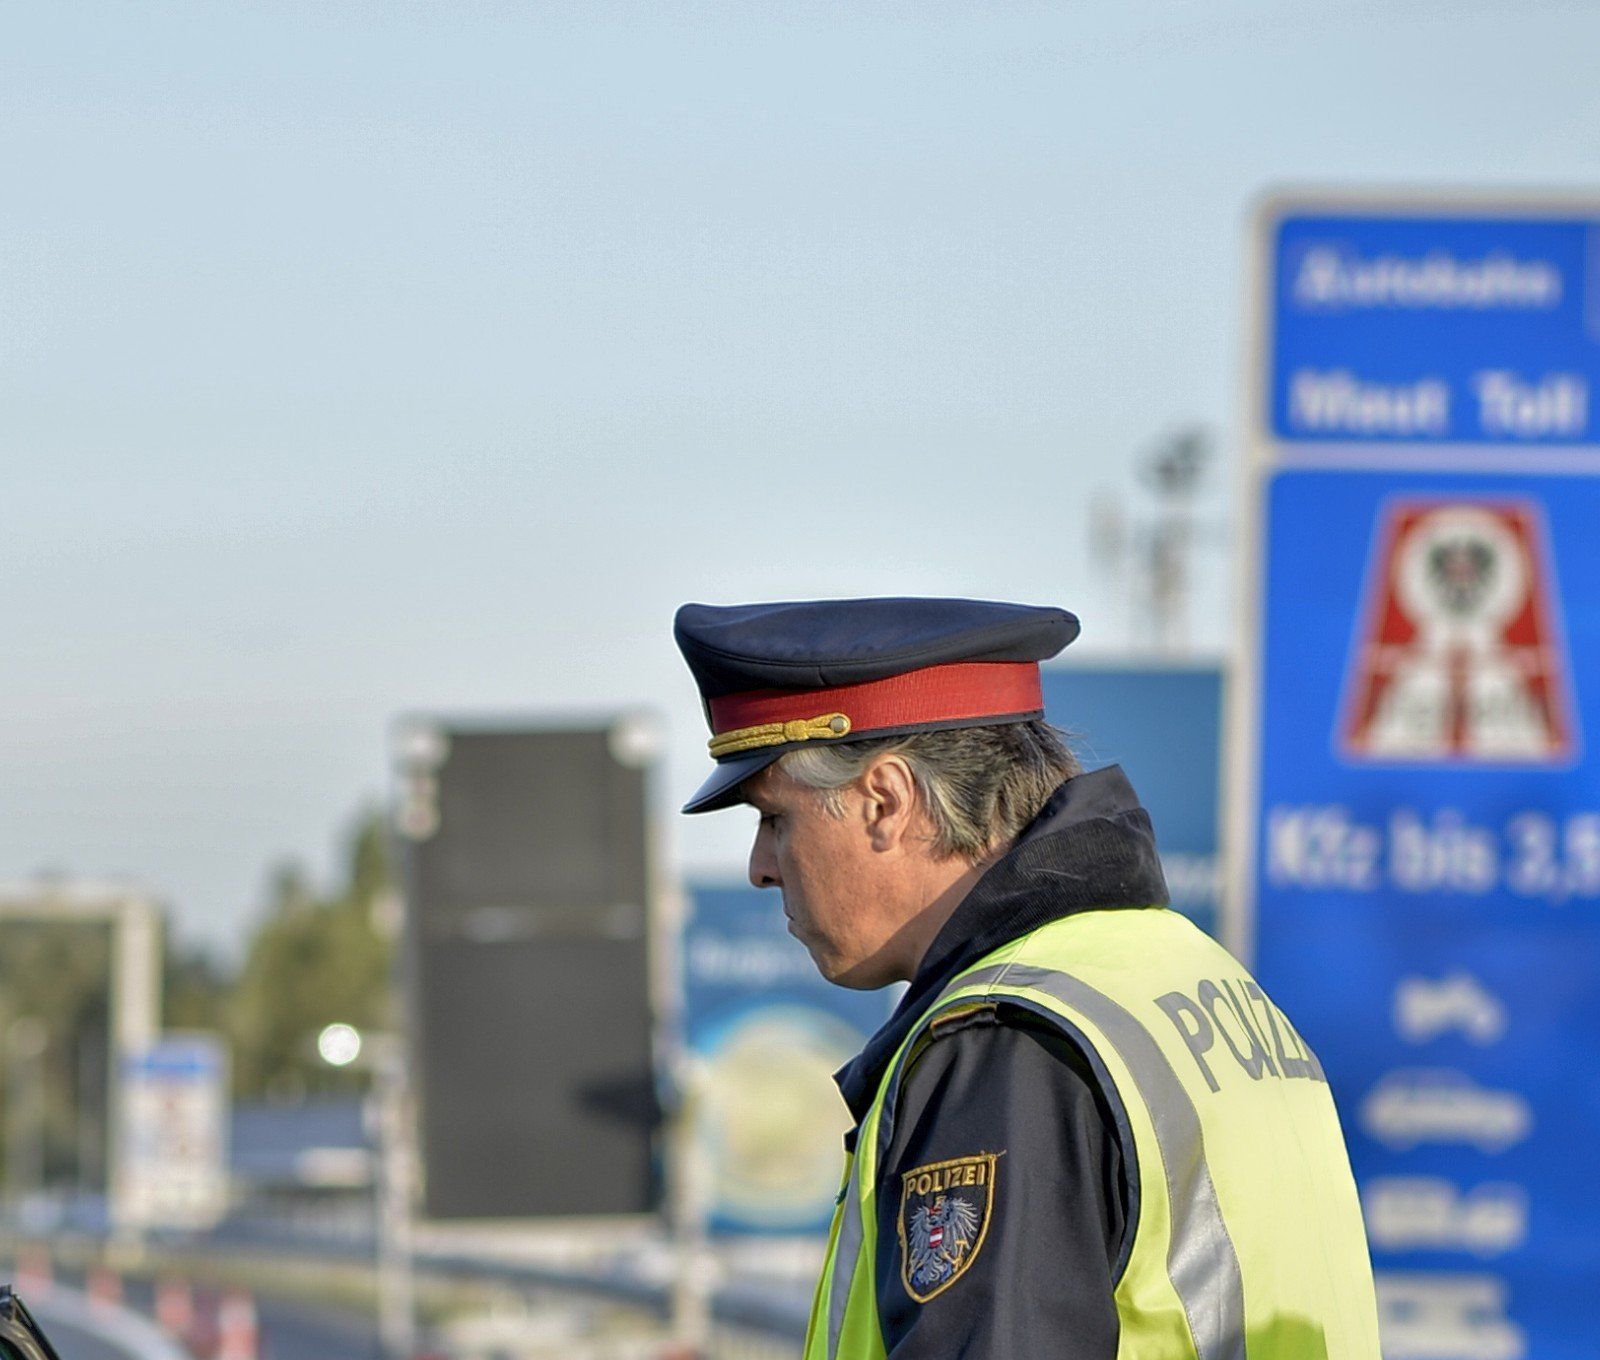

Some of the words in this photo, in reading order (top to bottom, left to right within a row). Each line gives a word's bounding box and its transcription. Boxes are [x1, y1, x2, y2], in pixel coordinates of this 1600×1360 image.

[1288, 371, 1450, 435] Maut
[1473, 370, 1588, 438] Toll
[1389, 805, 1498, 893] bis
[907, 1164, 985, 1199] POLIZEI
